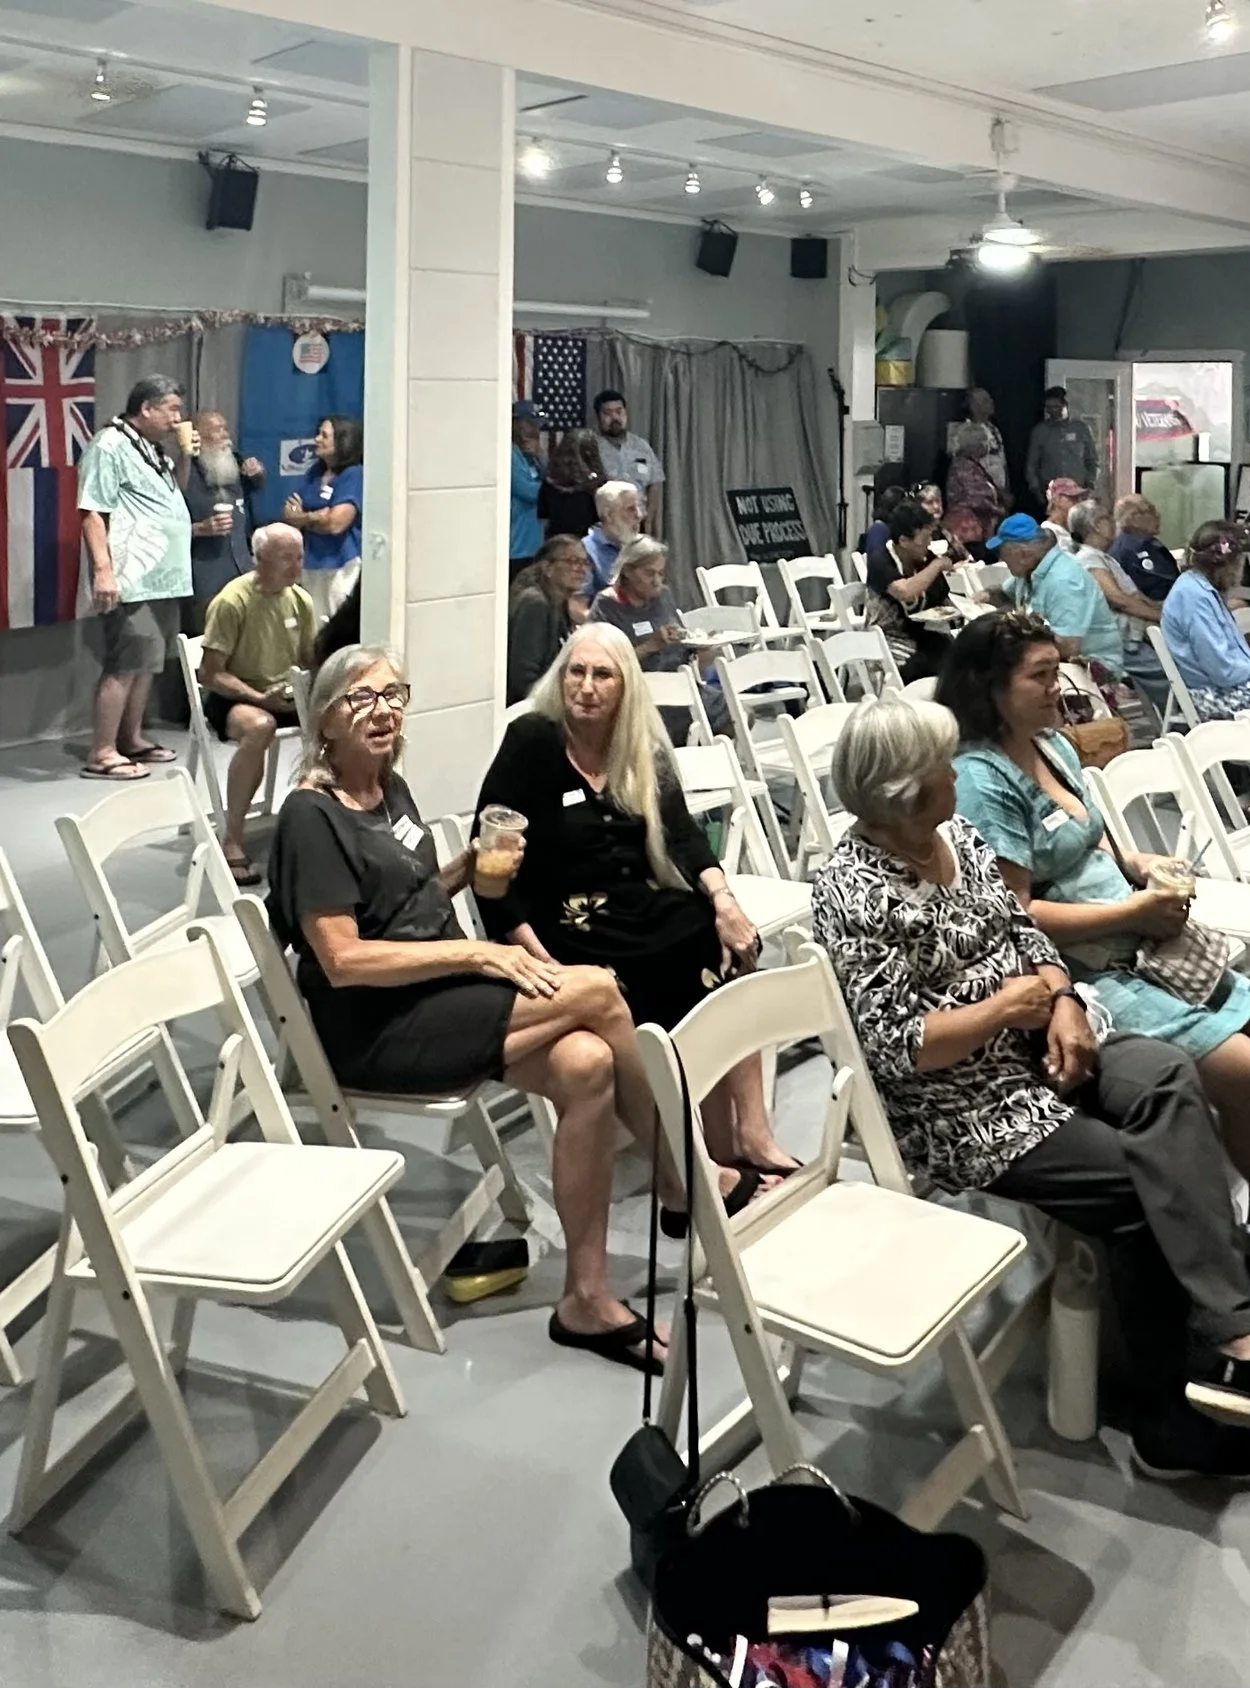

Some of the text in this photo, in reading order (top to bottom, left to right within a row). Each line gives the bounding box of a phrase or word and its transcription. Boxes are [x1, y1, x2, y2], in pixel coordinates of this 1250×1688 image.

[736, 493, 795, 515] NOT USING
[739, 520, 808, 545] DUE PROCESS
